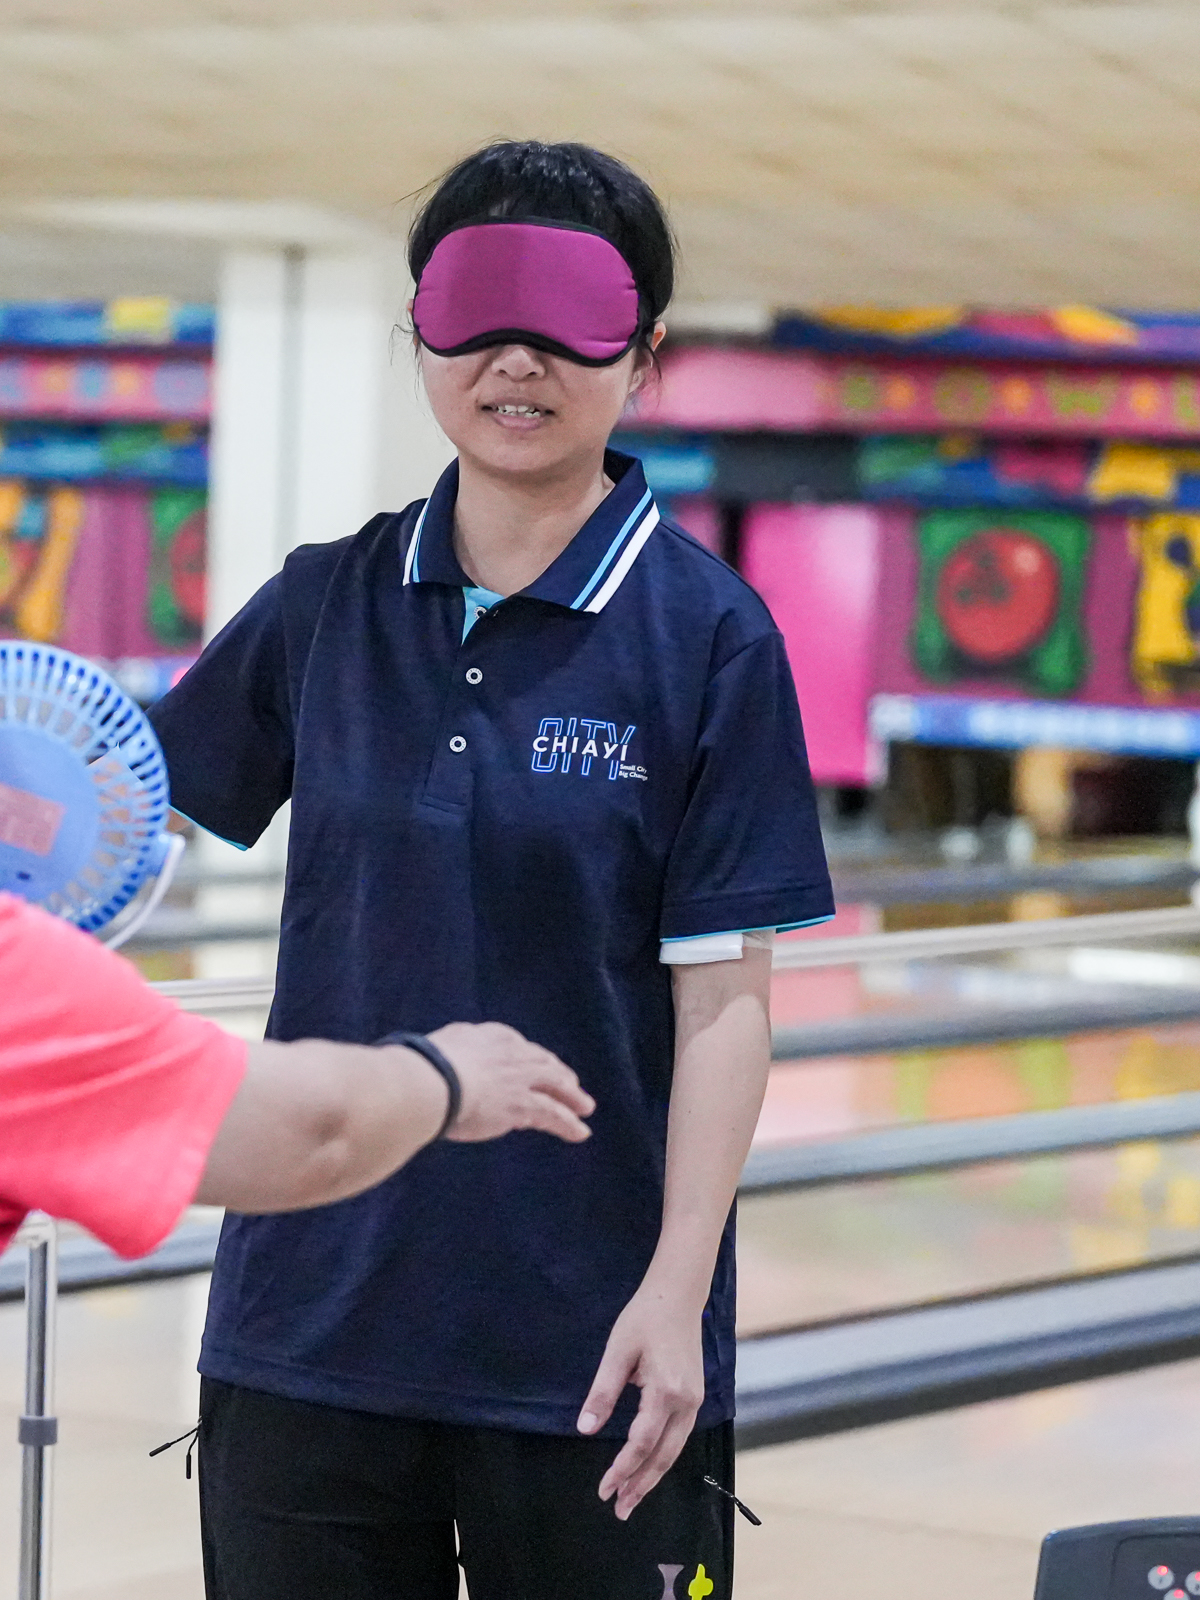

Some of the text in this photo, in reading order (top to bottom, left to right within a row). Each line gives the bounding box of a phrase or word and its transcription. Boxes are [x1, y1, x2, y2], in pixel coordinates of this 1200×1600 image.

[531, 717, 636, 780] CITY
[532, 736, 628, 761] CHIAYI
[618, 770, 629, 778] Big
[619, 763, 636, 771] Small
